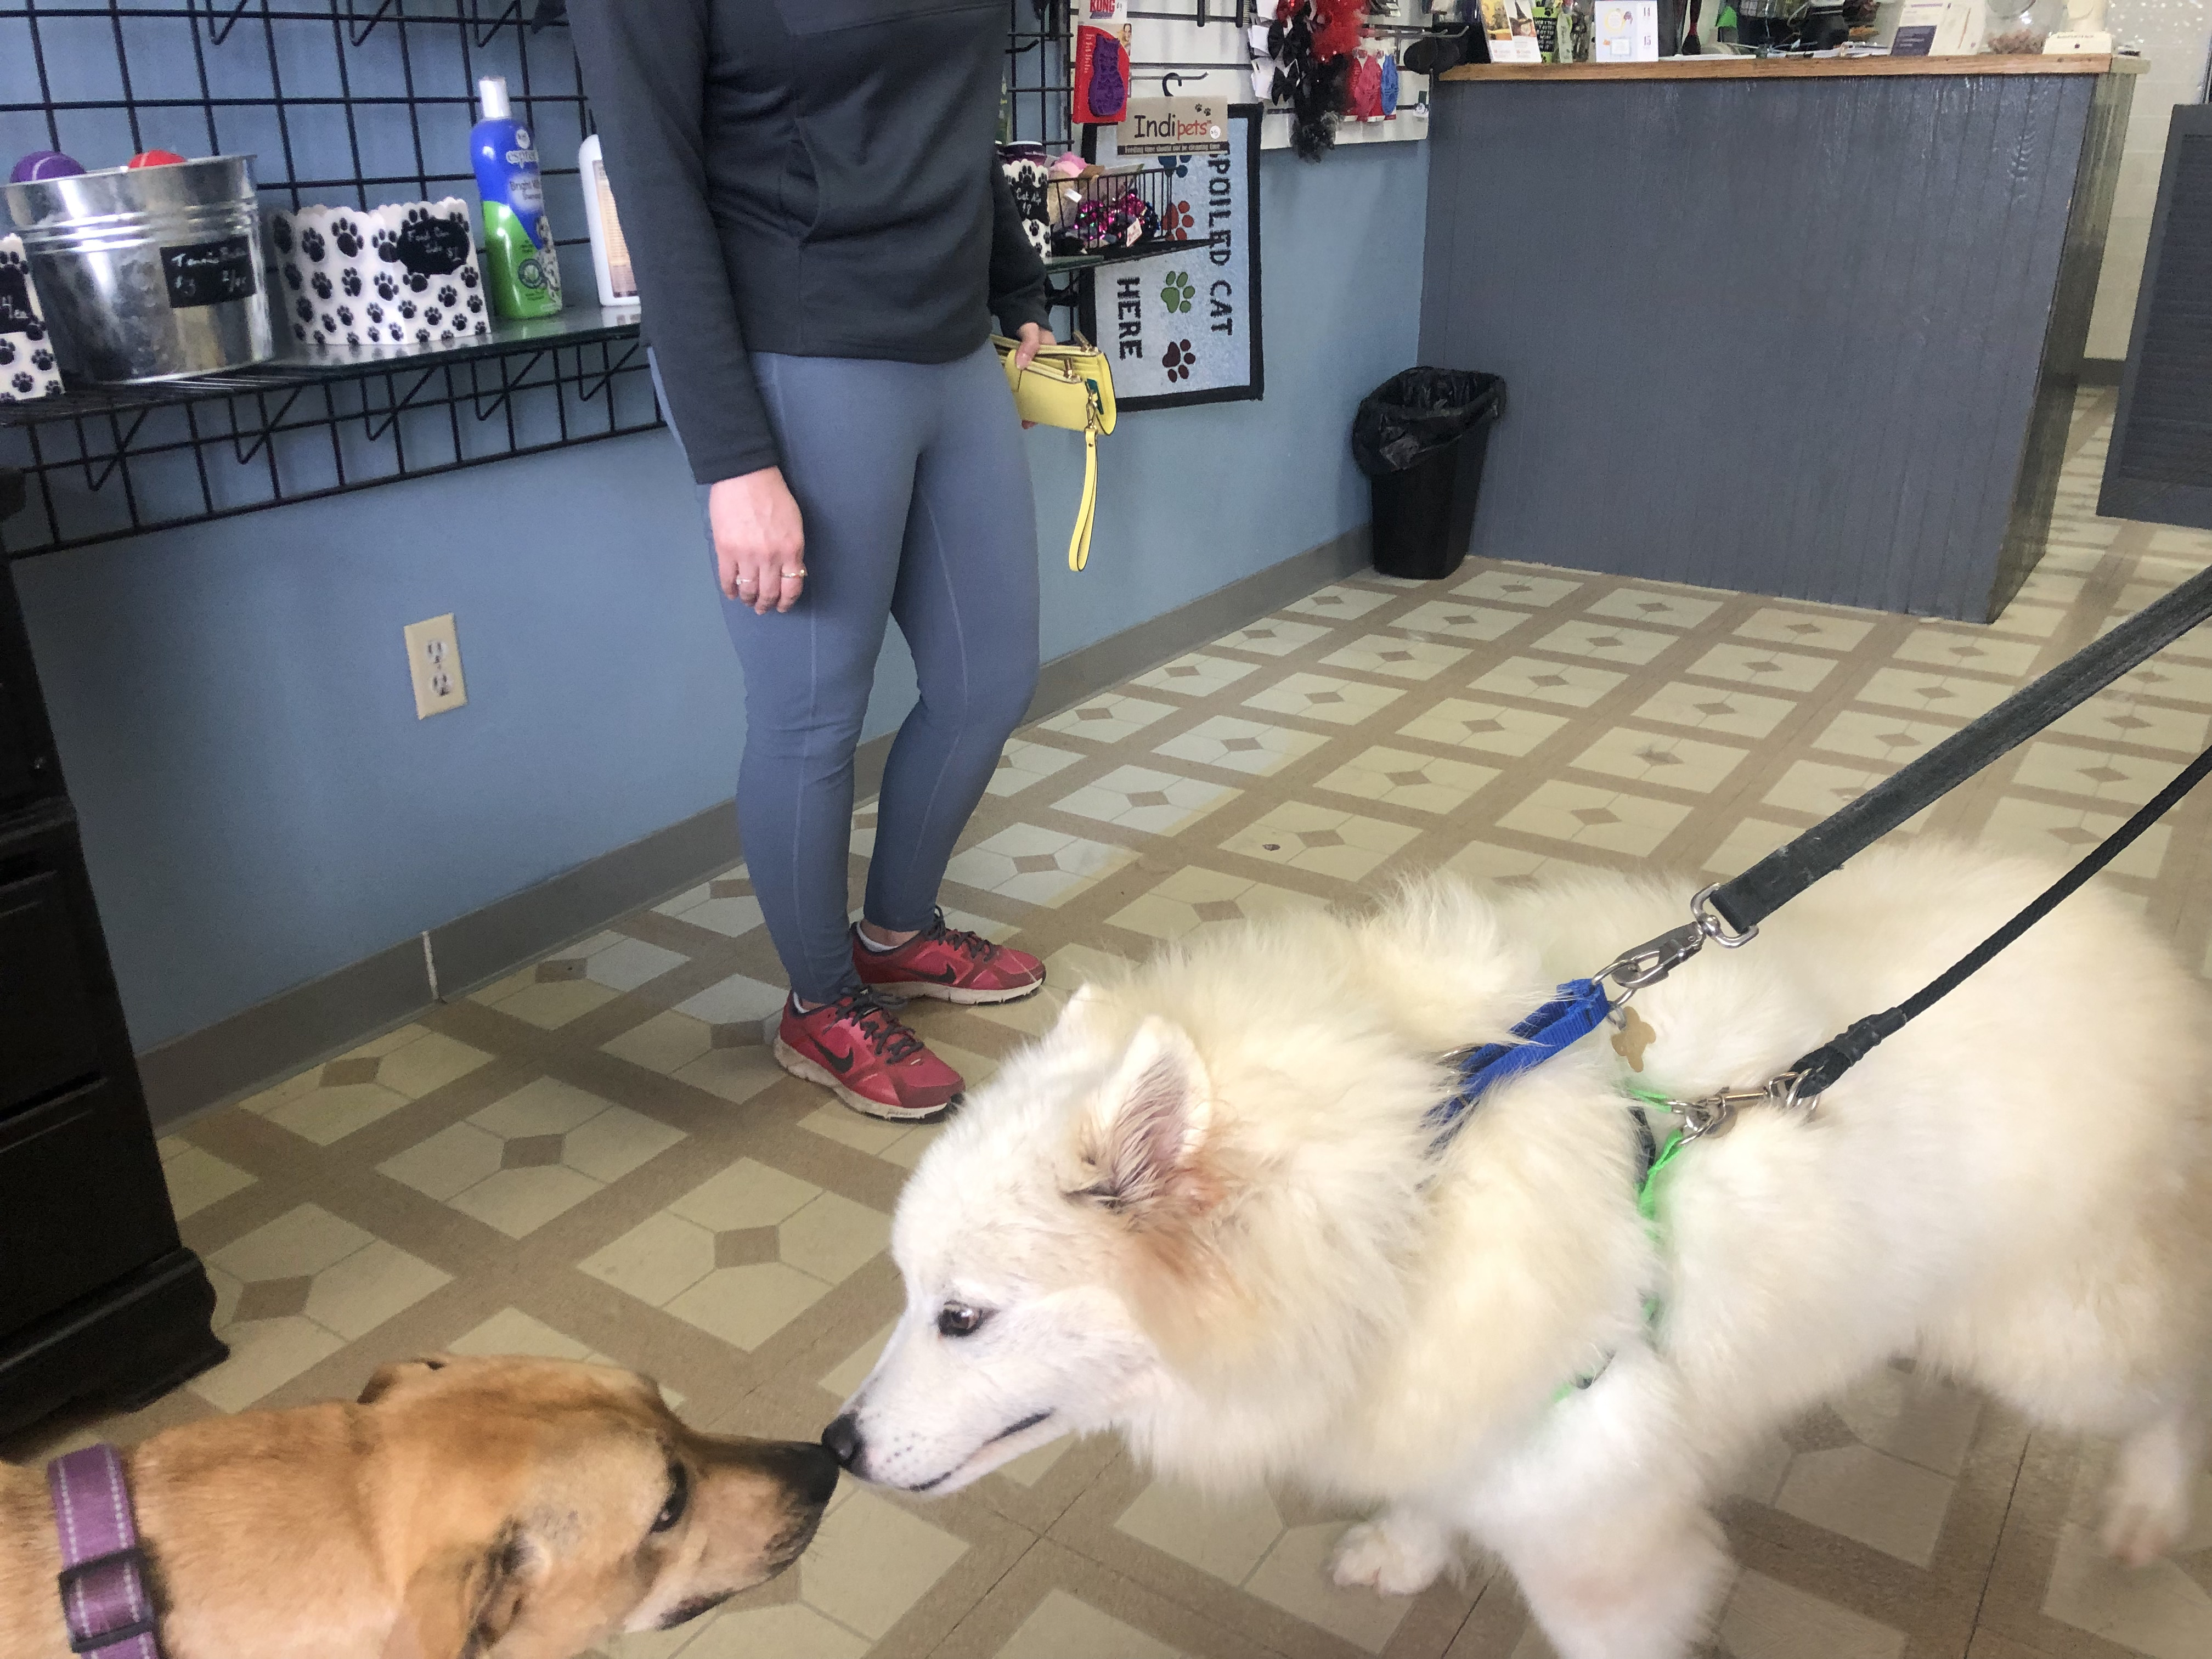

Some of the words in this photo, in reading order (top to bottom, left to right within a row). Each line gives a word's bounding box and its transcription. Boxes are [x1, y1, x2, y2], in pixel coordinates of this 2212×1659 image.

[1090, 0, 1116, 12] KONG
[1134, 113, 1207, 140] Indipets
[1207, 154, 1232, 266] POILED
[1117, 276, 1143, 360] HERE
[1210, 280, 1233, 336] CAT
